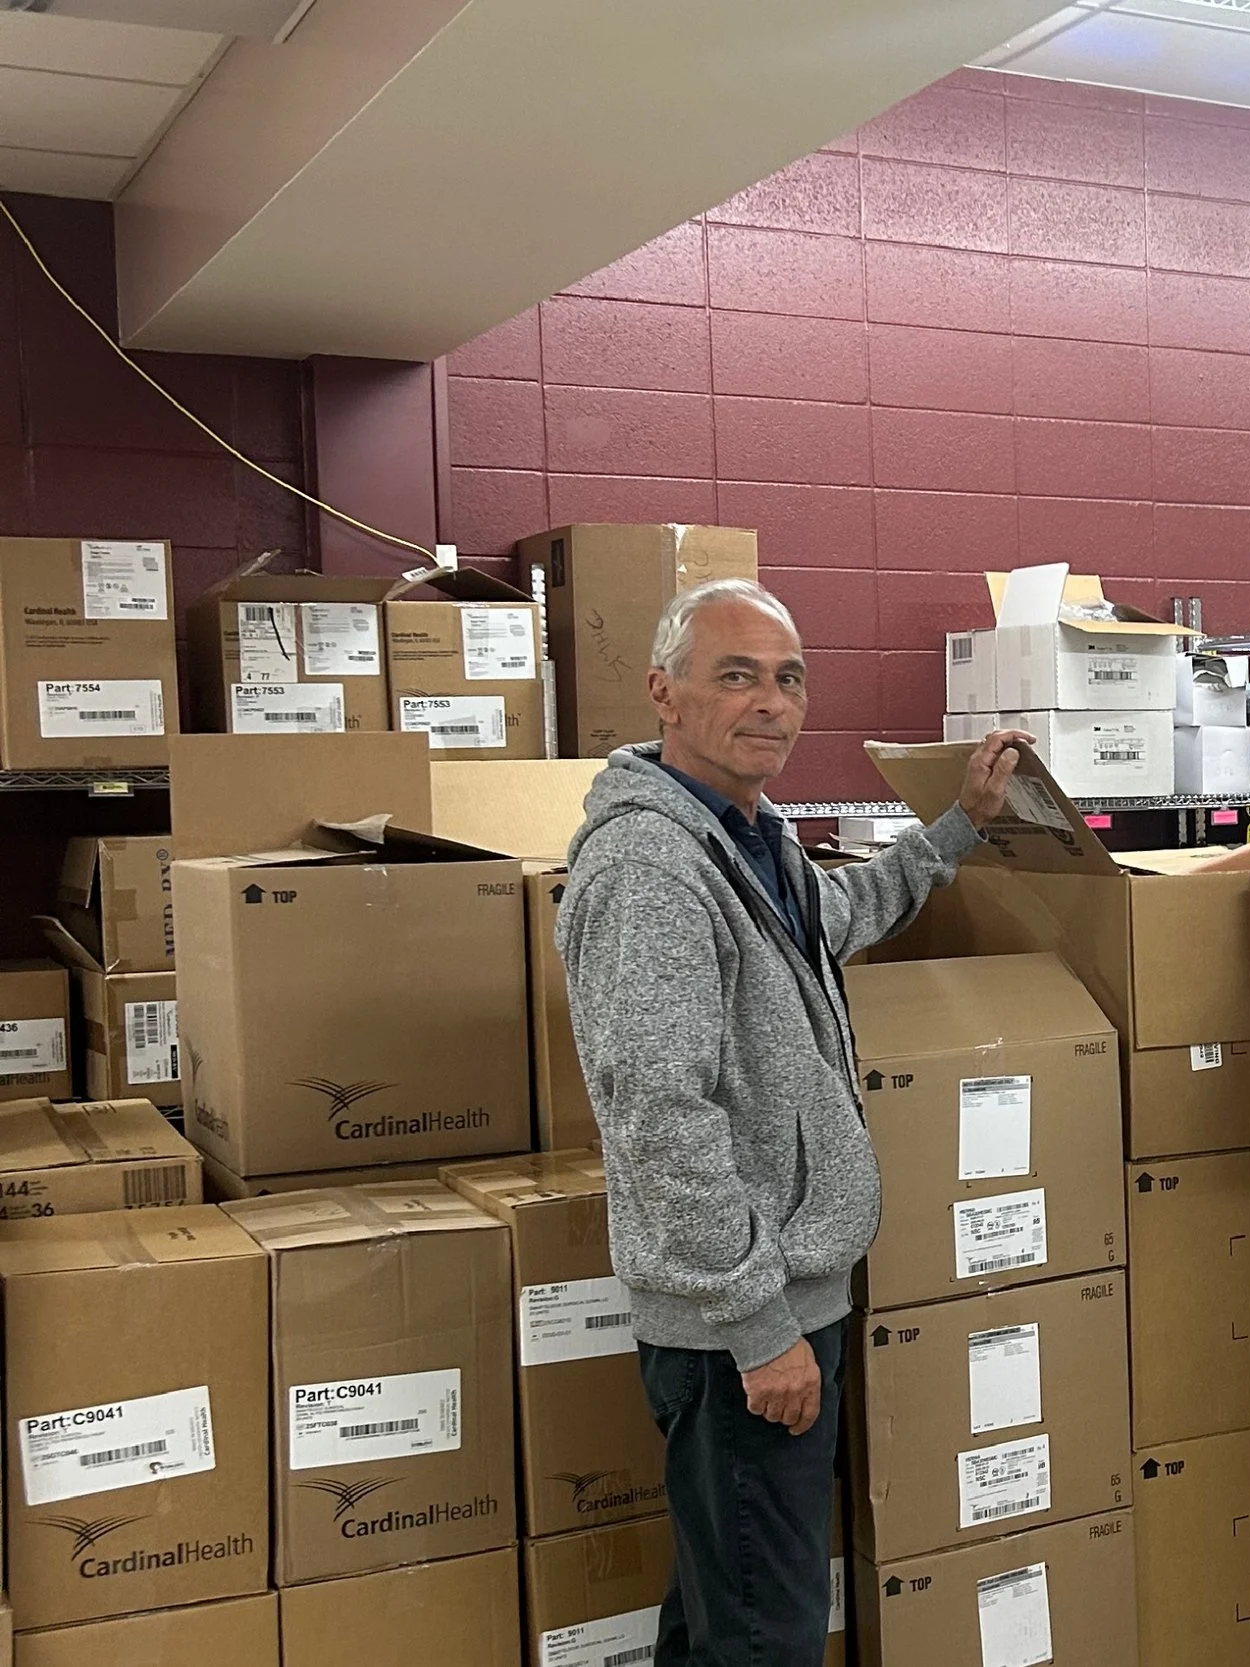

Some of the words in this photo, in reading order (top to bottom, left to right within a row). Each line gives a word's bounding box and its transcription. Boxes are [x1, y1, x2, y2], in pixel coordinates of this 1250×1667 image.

[272, 890, 297, 904] TOP
[477, 882, 516, 898] FRAGILE
[1074, 1041, 1107, 1057] FRAGILE
[891, 1074, 914, 1090] TOP
[335, 1107, 490, 1141] CardinalHealth
[1159, 1176, 1180, 1193] TOP
[31, 1203, 55, 1217] 36
[1104, 1232, 1114, 1246] 65
[1108, 1249, 1115, 1262] G
[1081, 1283, 1114, 1300] FRAGILE
[897, 1327, 920, 1344] TOP
[1164, 1460, 1185, 1477] TOP
[1110, 1473, 1121, 1487] 65
[577, 1483, 668, 1513] CardinalHealt
[1114, 1490, 1121, 1502] G
[340, 1495, 498, 1539] CardinalHealth
[1089, 1521, 1122, 1540] FRAGILE
[79, 1533, 254, 1579] CardinalHealth
[909, 1576, 932, 1592] TOP
